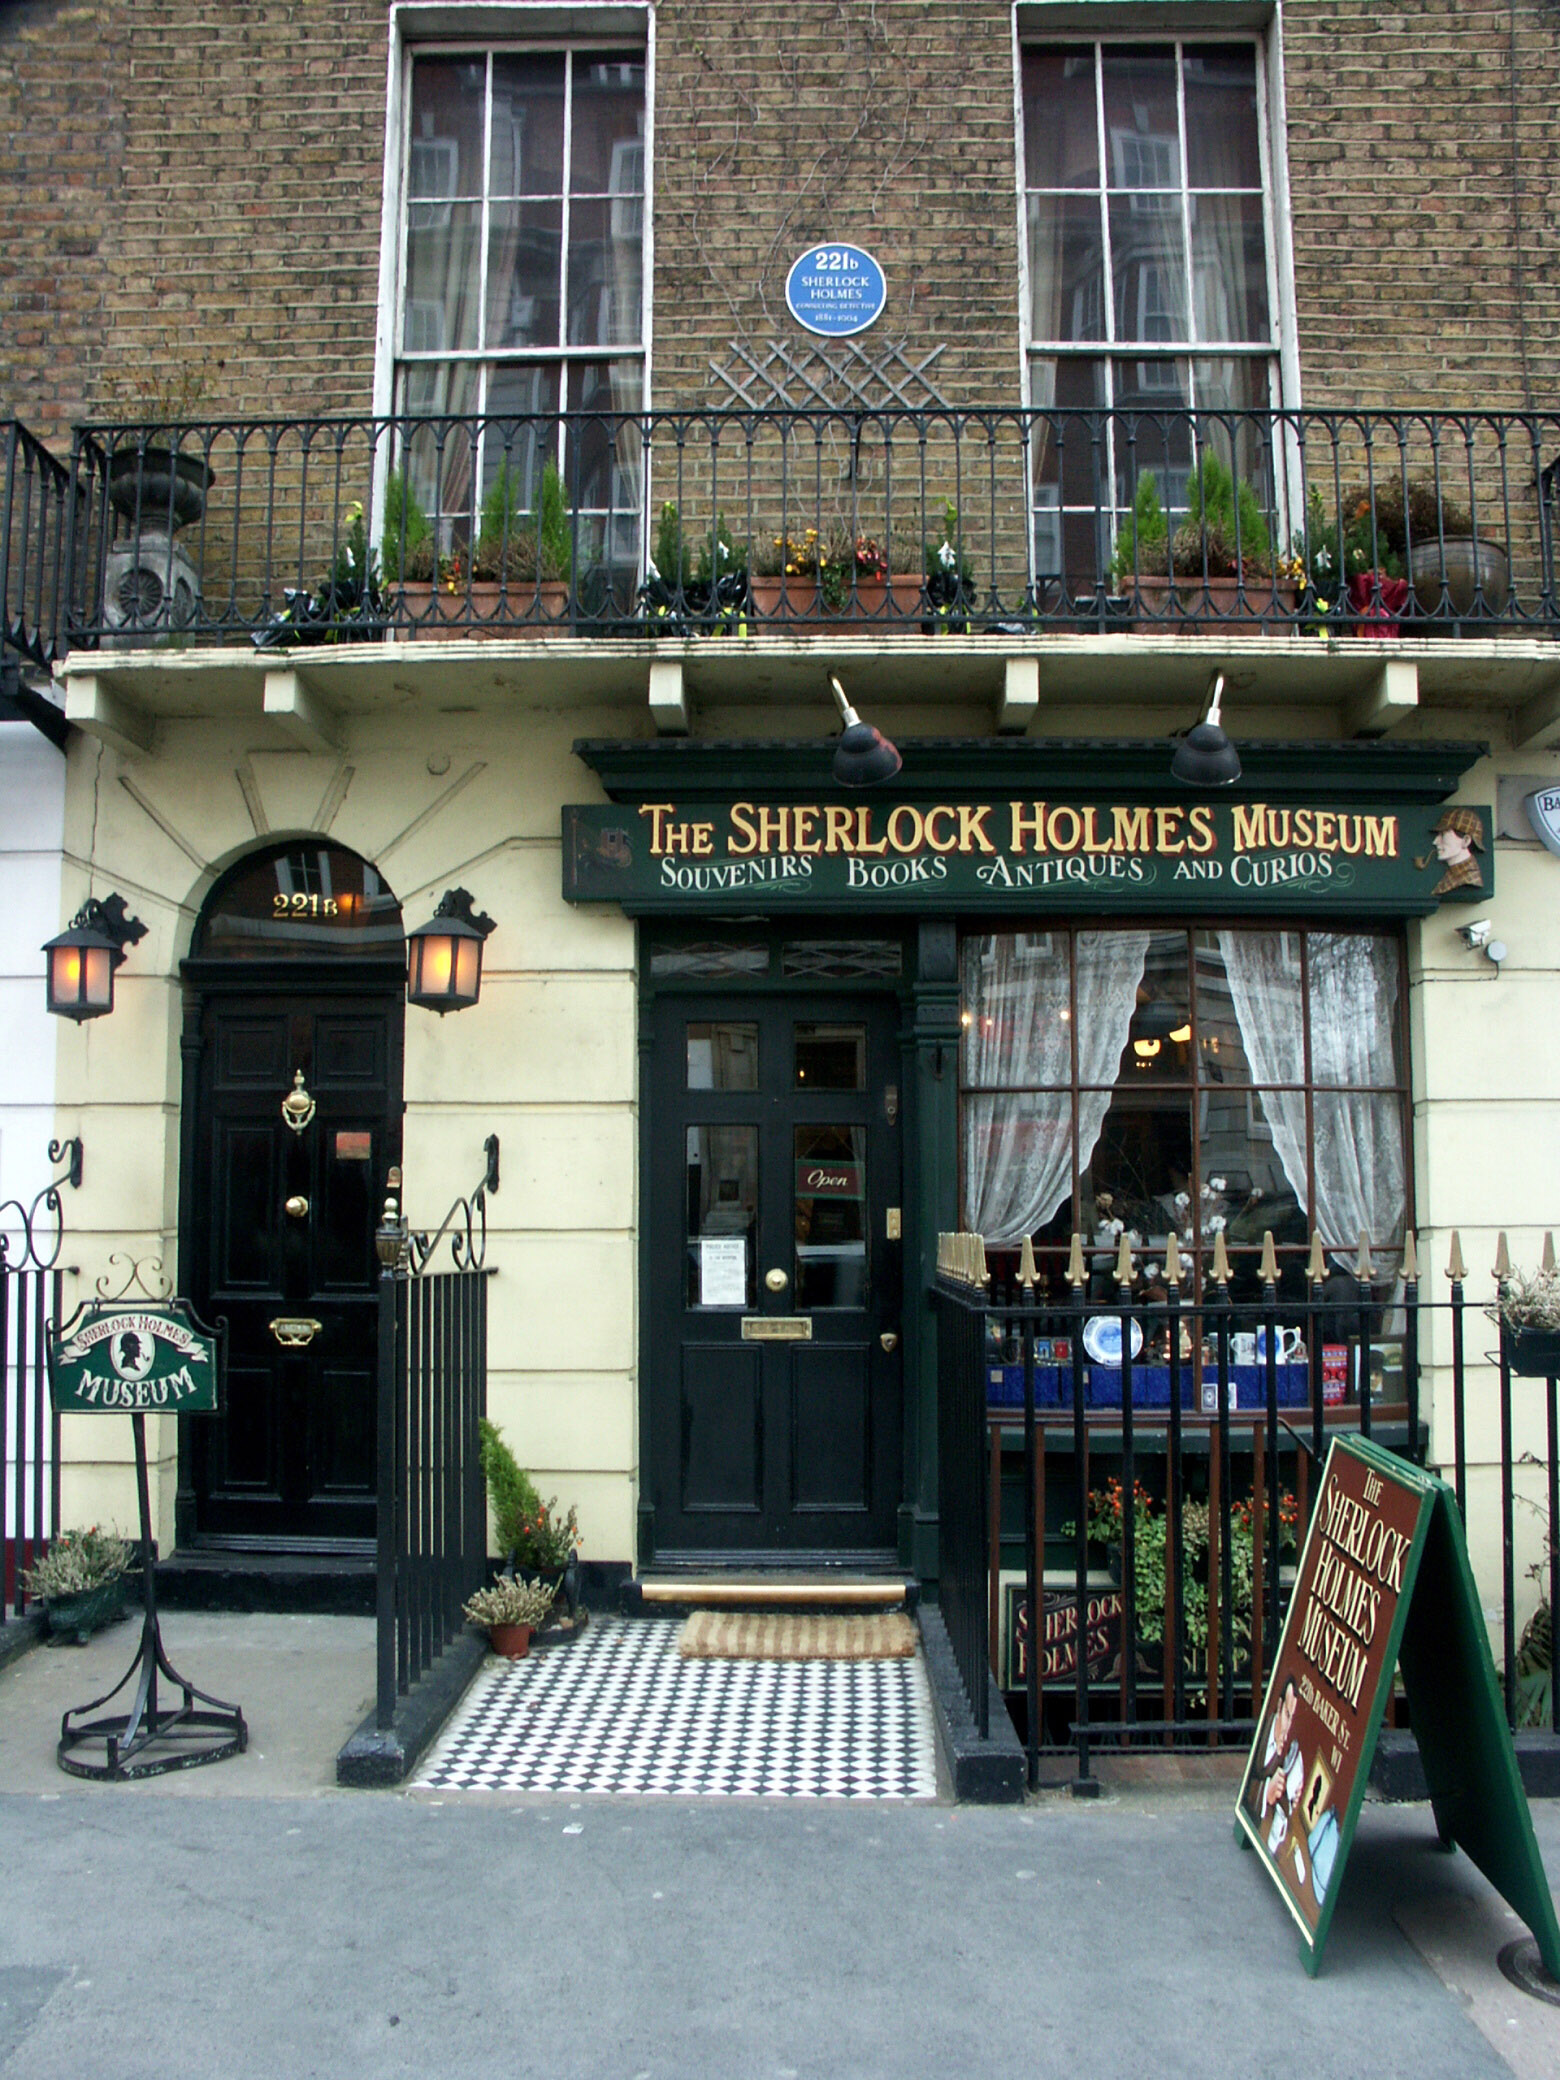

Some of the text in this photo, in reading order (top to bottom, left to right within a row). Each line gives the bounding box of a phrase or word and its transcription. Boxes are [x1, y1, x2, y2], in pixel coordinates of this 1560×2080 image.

[815, 252, 858, 271] 221b
[801, 276, 870, 287] SHERLOCK
[810, 288, 862, 299] HOLMES
[795, 302, 876, 310] CONSULTING DETECTIVE
[638, 801, 1398, 857] THE SHERLOCK HOLMES MUSEUM
[660, 852, 1334, 890] SOUVENIRS BOOKS ANTIQUES AND CURIOS
[272, 893, 338, 918] 221B
[807, 1169, 848, 1189] Open
[76, 1314, 190, 1348] SHERLOCK HOLMES
[74, 1365, 198, 1407] MUSEUM
[1363, 1467, 1384, 1507] THE
[1319, 1474, 1412, 1593] SHERLOCK
[1311, 1540, 1381, 1645] HOLMES
[1298, 1596, 1369, 1710] MUSEUM
[1312, 1690, 1340, 1737] BAKER
[1338, 1720, 1351, 1751] ST.
